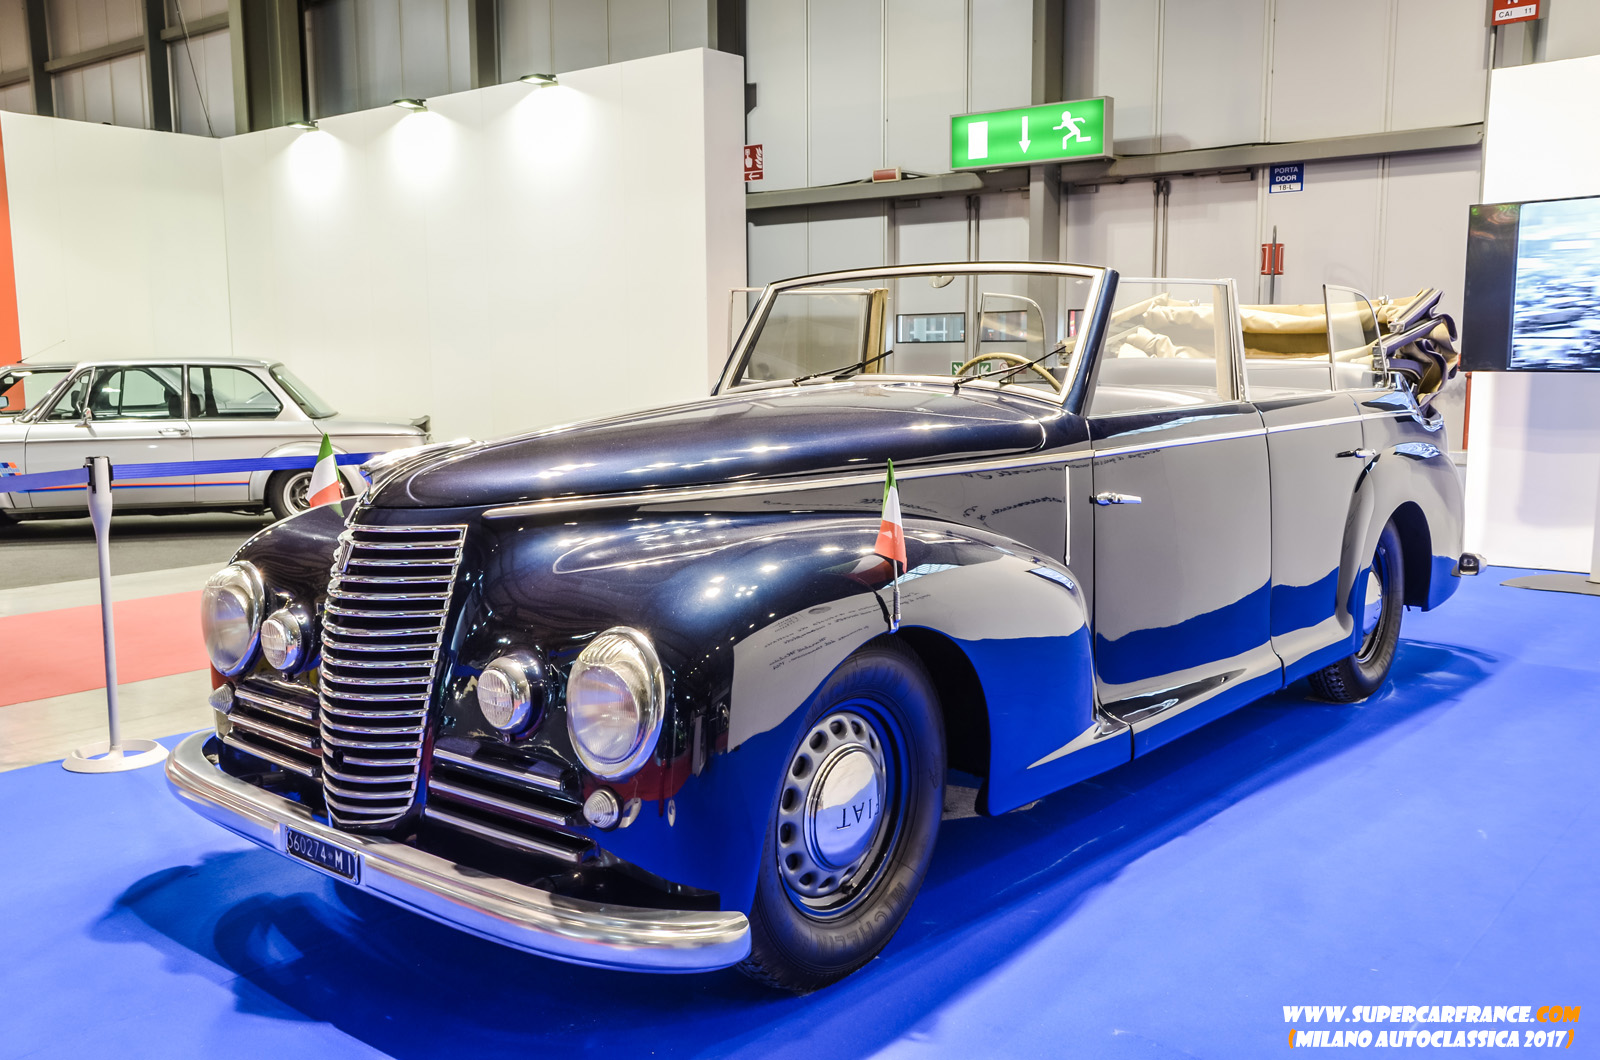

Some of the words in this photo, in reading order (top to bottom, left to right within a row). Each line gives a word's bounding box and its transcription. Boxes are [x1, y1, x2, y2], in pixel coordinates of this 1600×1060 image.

[1498, 10, 1513, 18] CAI
[1274, 166, 1299, 174] PORTA
[1275, 174, 1297, 182] DOOR
[836, 793, 880, 830] FIAT
[288, 831, 326, 862] 360274
[817, 881, 911, 953] MICHELIN
